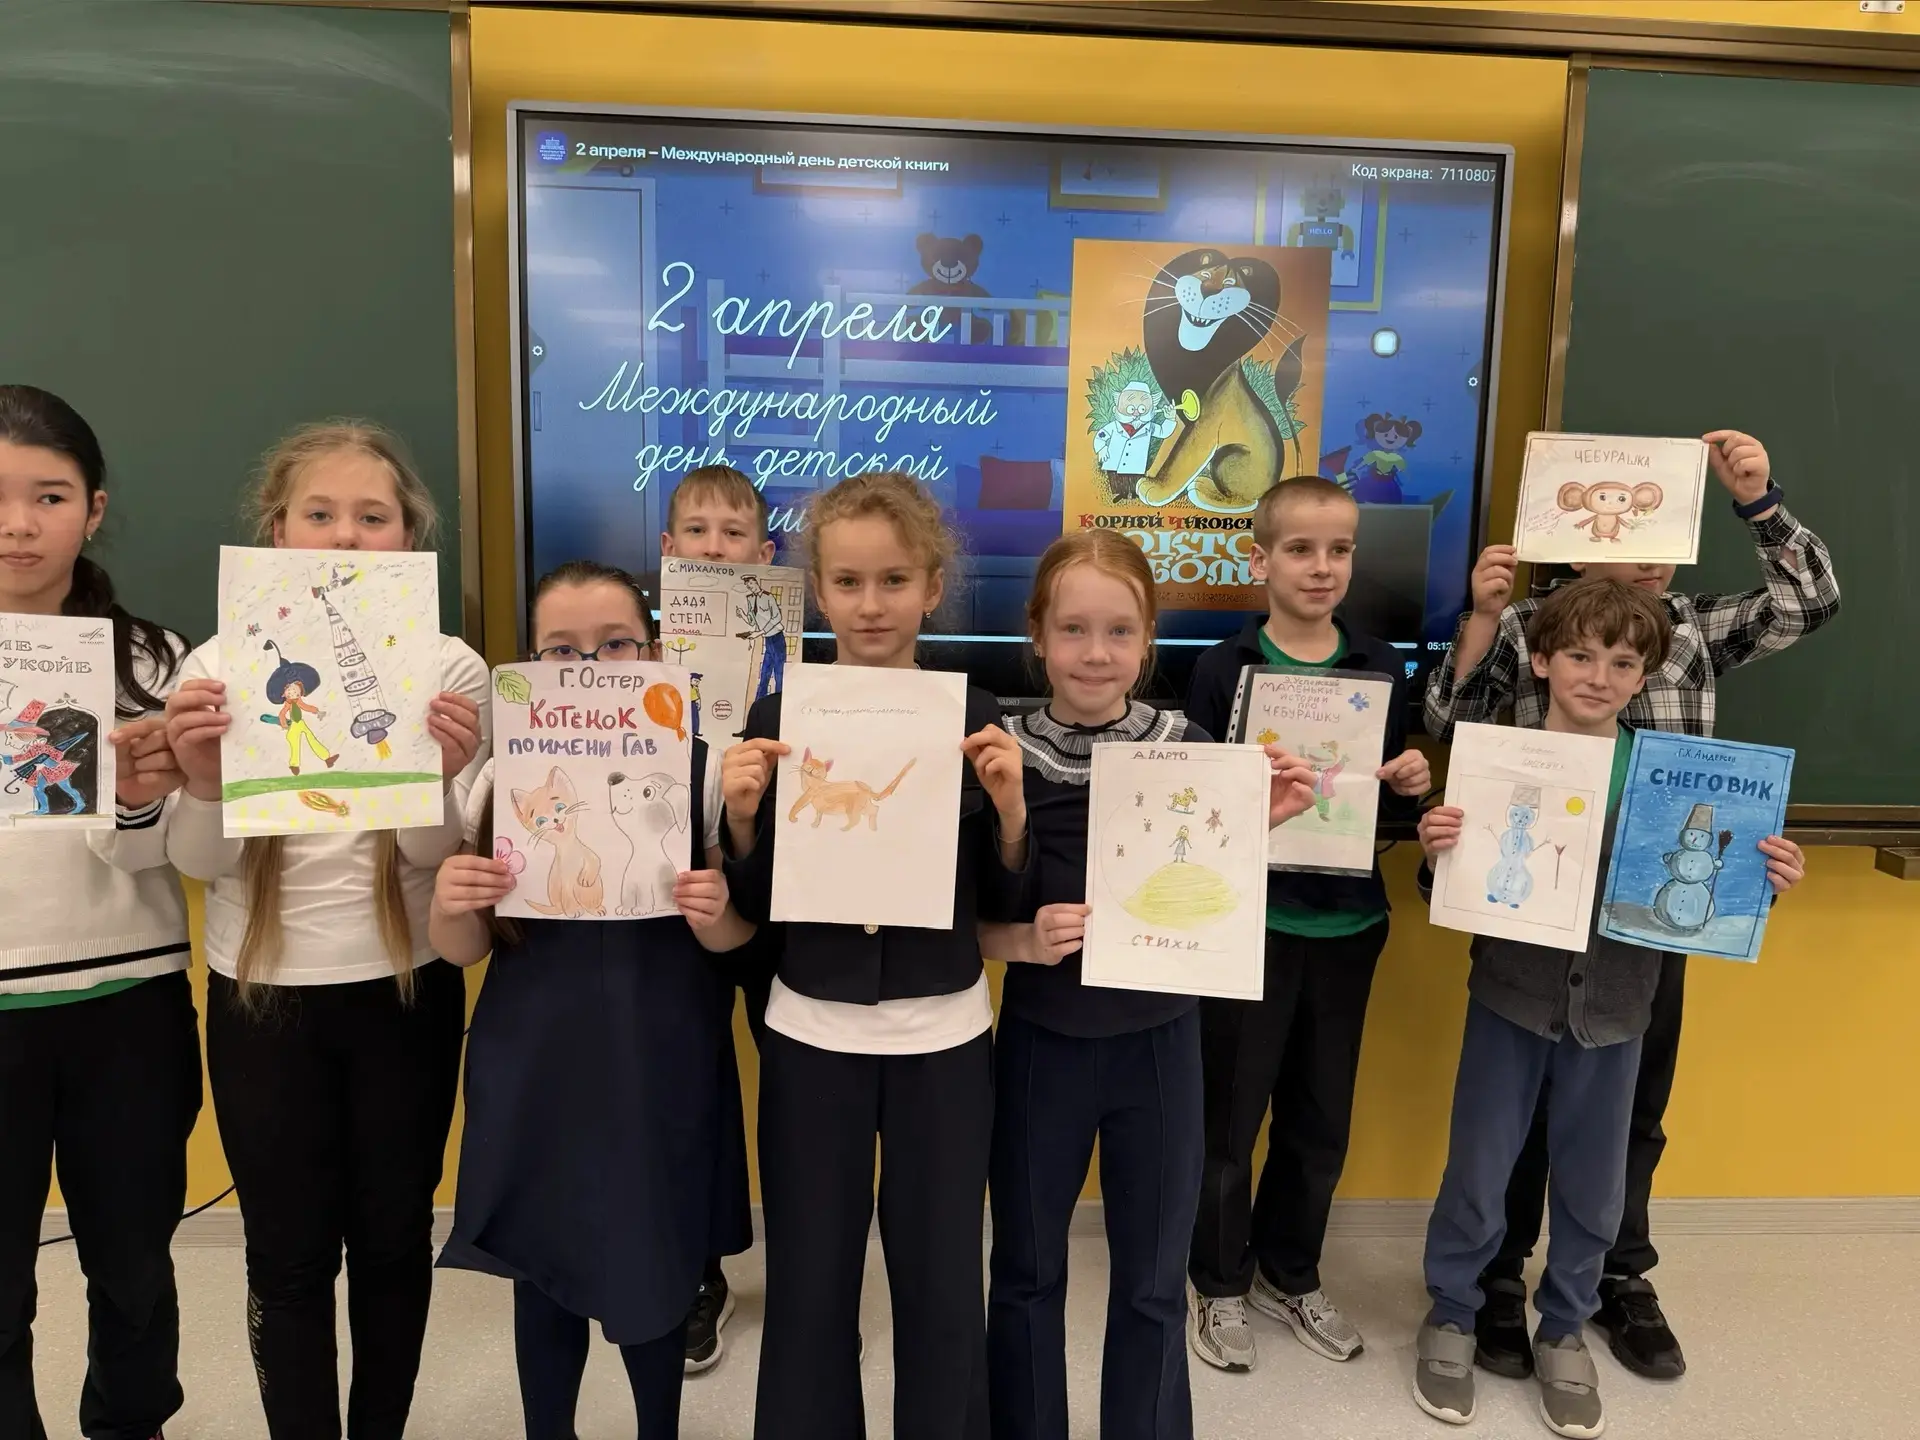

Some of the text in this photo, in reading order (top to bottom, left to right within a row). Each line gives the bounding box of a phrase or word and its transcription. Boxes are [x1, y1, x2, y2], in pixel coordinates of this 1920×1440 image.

[576, 143, 586, 156] 2
[589, 147, 646, 159] апреля
[661, 146, 795, 165] Международный
[798, 153, 835, 167] день
[838, 156, 902, 170] детской
[905, 160, 949, 172] книги
[1351, 164, 1378, 180] Код
[1381, 166, 1433, 181] экрана:
[648, 261, 952, 369] 2 апреля
[578, 361, 998, 443] Международный
[633, 443, 736, 491] день
[1574, 449, 1650, 468] ЧЕБУРАШКА
[1121, 530, 1254, 560] ОКТО
[670, 595, 706, 608] ДЯДЯ
[669, 612, 712, 624] СТЕПА
[1260, 681, 1344, 696] МАЛЕНЬКИЕ
[1280, 694, 1328, 703] ИСТОРИИ
[1298, 702, 1318, 710] ПРО
[1263, 704, 1340, 724] ЧЕБУРАШКУ
[1650, 768, 1774, 801] СНЕГОВИК
[1131, 934, 1200, 951] СТИХИ
